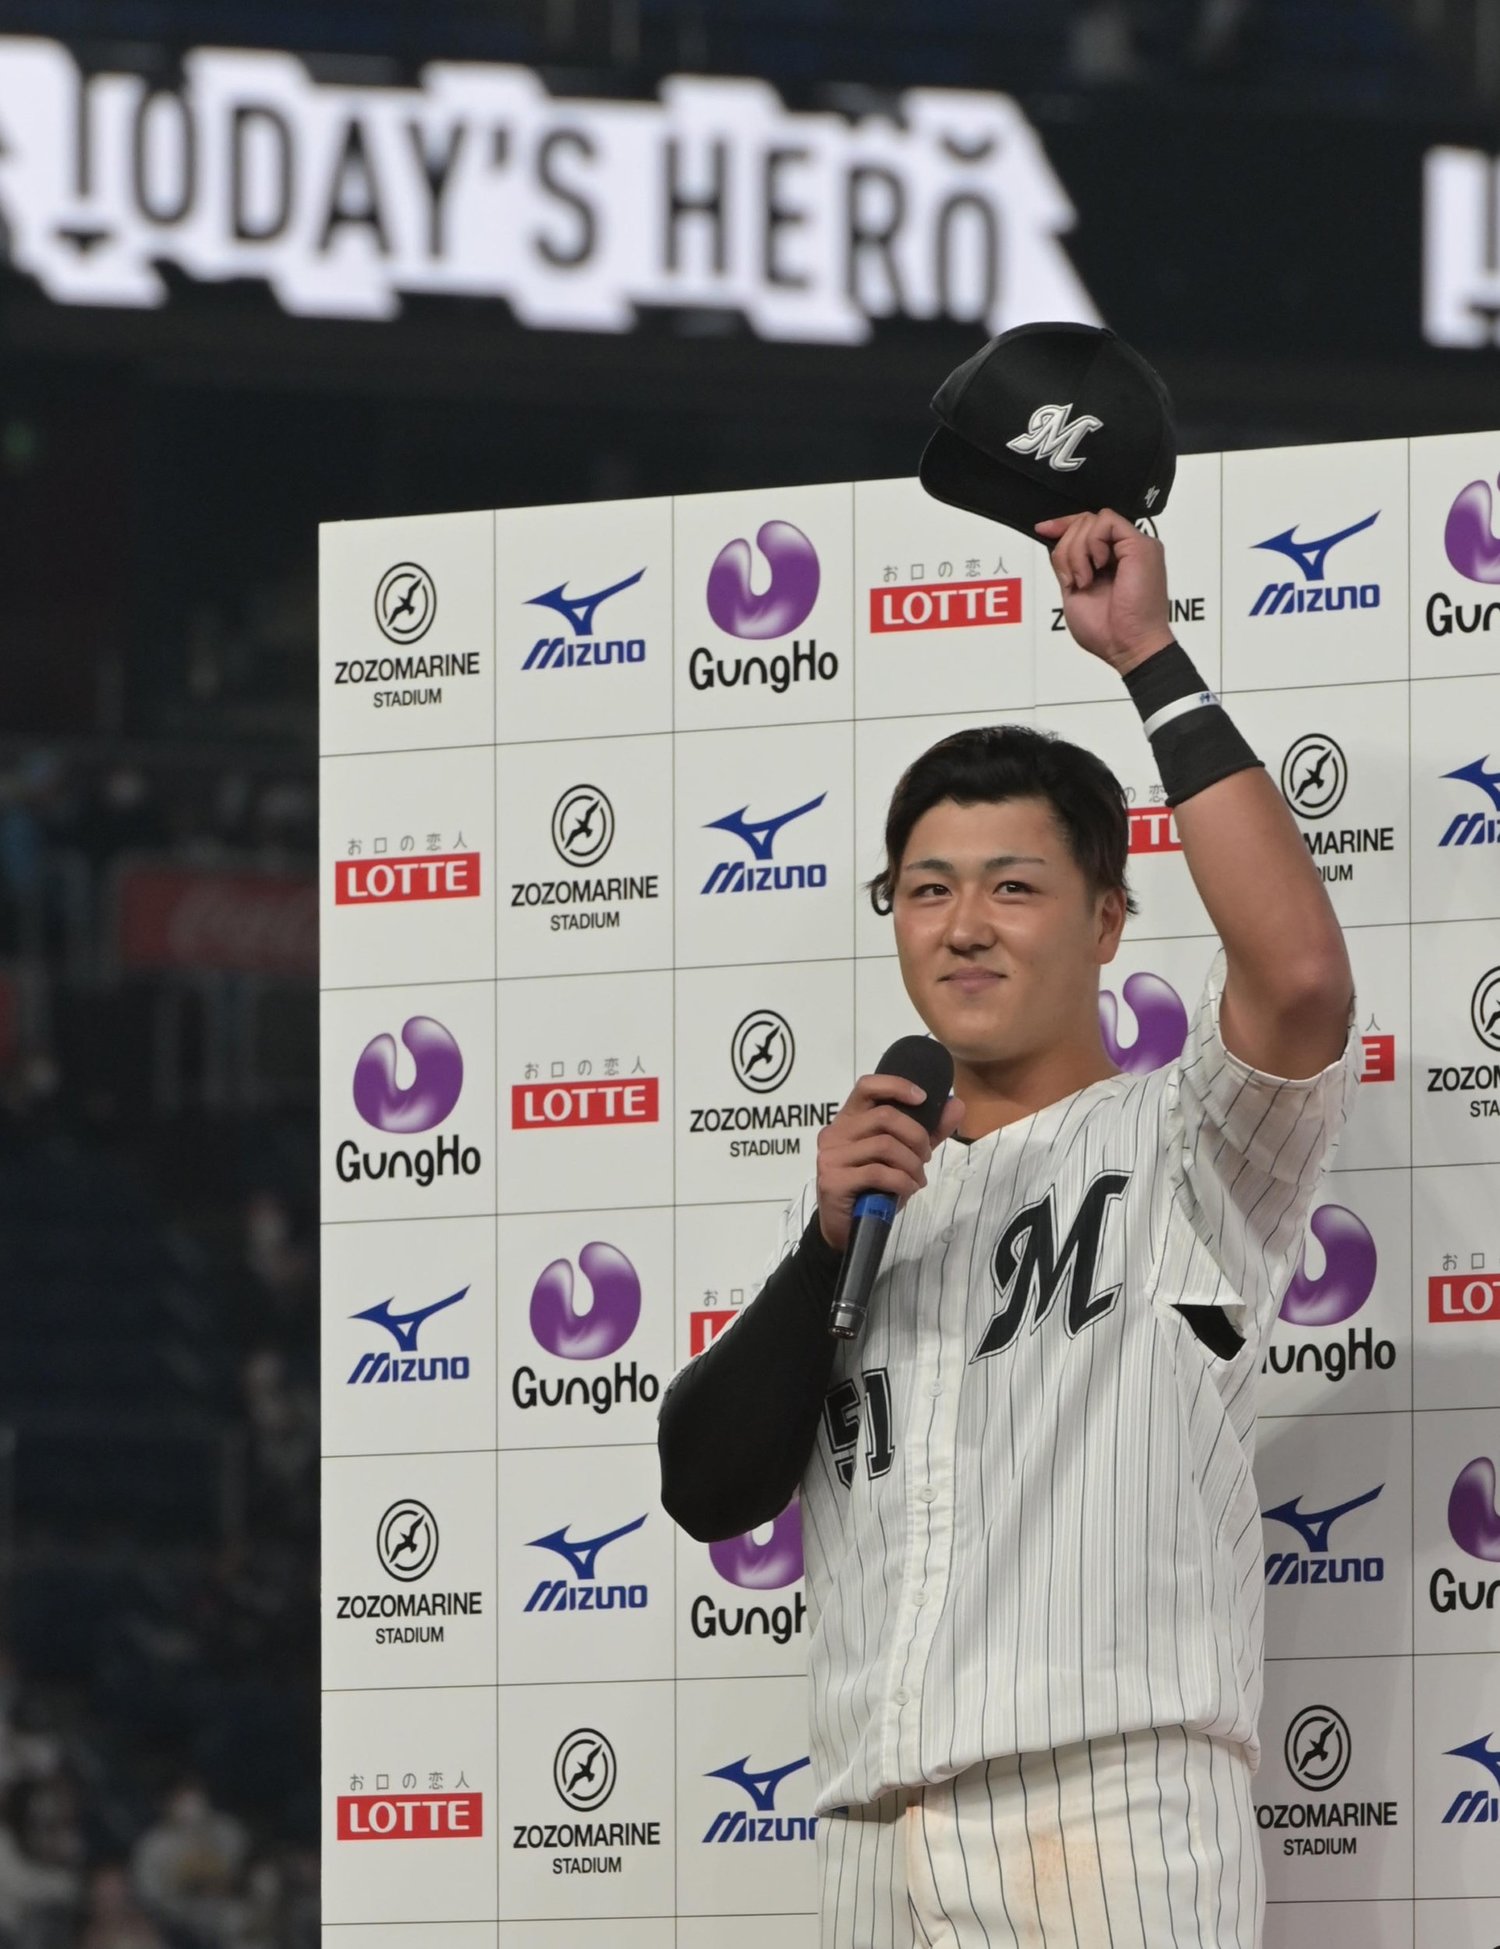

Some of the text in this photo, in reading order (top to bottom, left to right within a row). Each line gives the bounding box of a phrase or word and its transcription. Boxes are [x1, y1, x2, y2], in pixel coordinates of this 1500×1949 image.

[1006, 403, 1104, 472] M
[883, 556, 1010, 583] お口の恋人
[883, 586, 1009, 625] LOTTE
[335, 652, 480, 684] ZOZOMARINE
[689, 640, 839, 693] GungHo
[373, 687, 442, 708] STADIUM
[347, 832, 468, 855] お口の恋人
[1304, 828, 1394, 855] MARINE
[1438, 813, 1500, 847] MI
[347, 860, 468, 898] LOTTE
[511, 876, 659, 907] ZOZOMARINE
[550, 912, 620, 931] STADIUM
[524, 1056, 646, 1079] お口の恋人
[524, 1085, 646, 1122] LOTTE
[336, 1135, 481, 1187] GungHo
[730, 1138, 800, 1157] STADIUM
[968, 1169, 1134, 1365] M
[1261, 1327, 1396, 1382] ungHo
[512, 1362, 660, 1414] GungHo
[337, 1592, 482, 1619] ZOZOMARINE
[691, 1592, 807, 1645] Gung
[375, 1626, 444, 1645] STADIUM
[350, 1771, 469, 1791] お口の恋人
[349, 1800, 470, 1834] LOTTE
[1254, 1802, 1397, 1829] OZOMARINE
[513, 1822, 661, 1849] ZOZOMARINE
[1283, 1837, 1357, 1856] STADIUM
[552, 1856, 622, 1875] STADIUM
